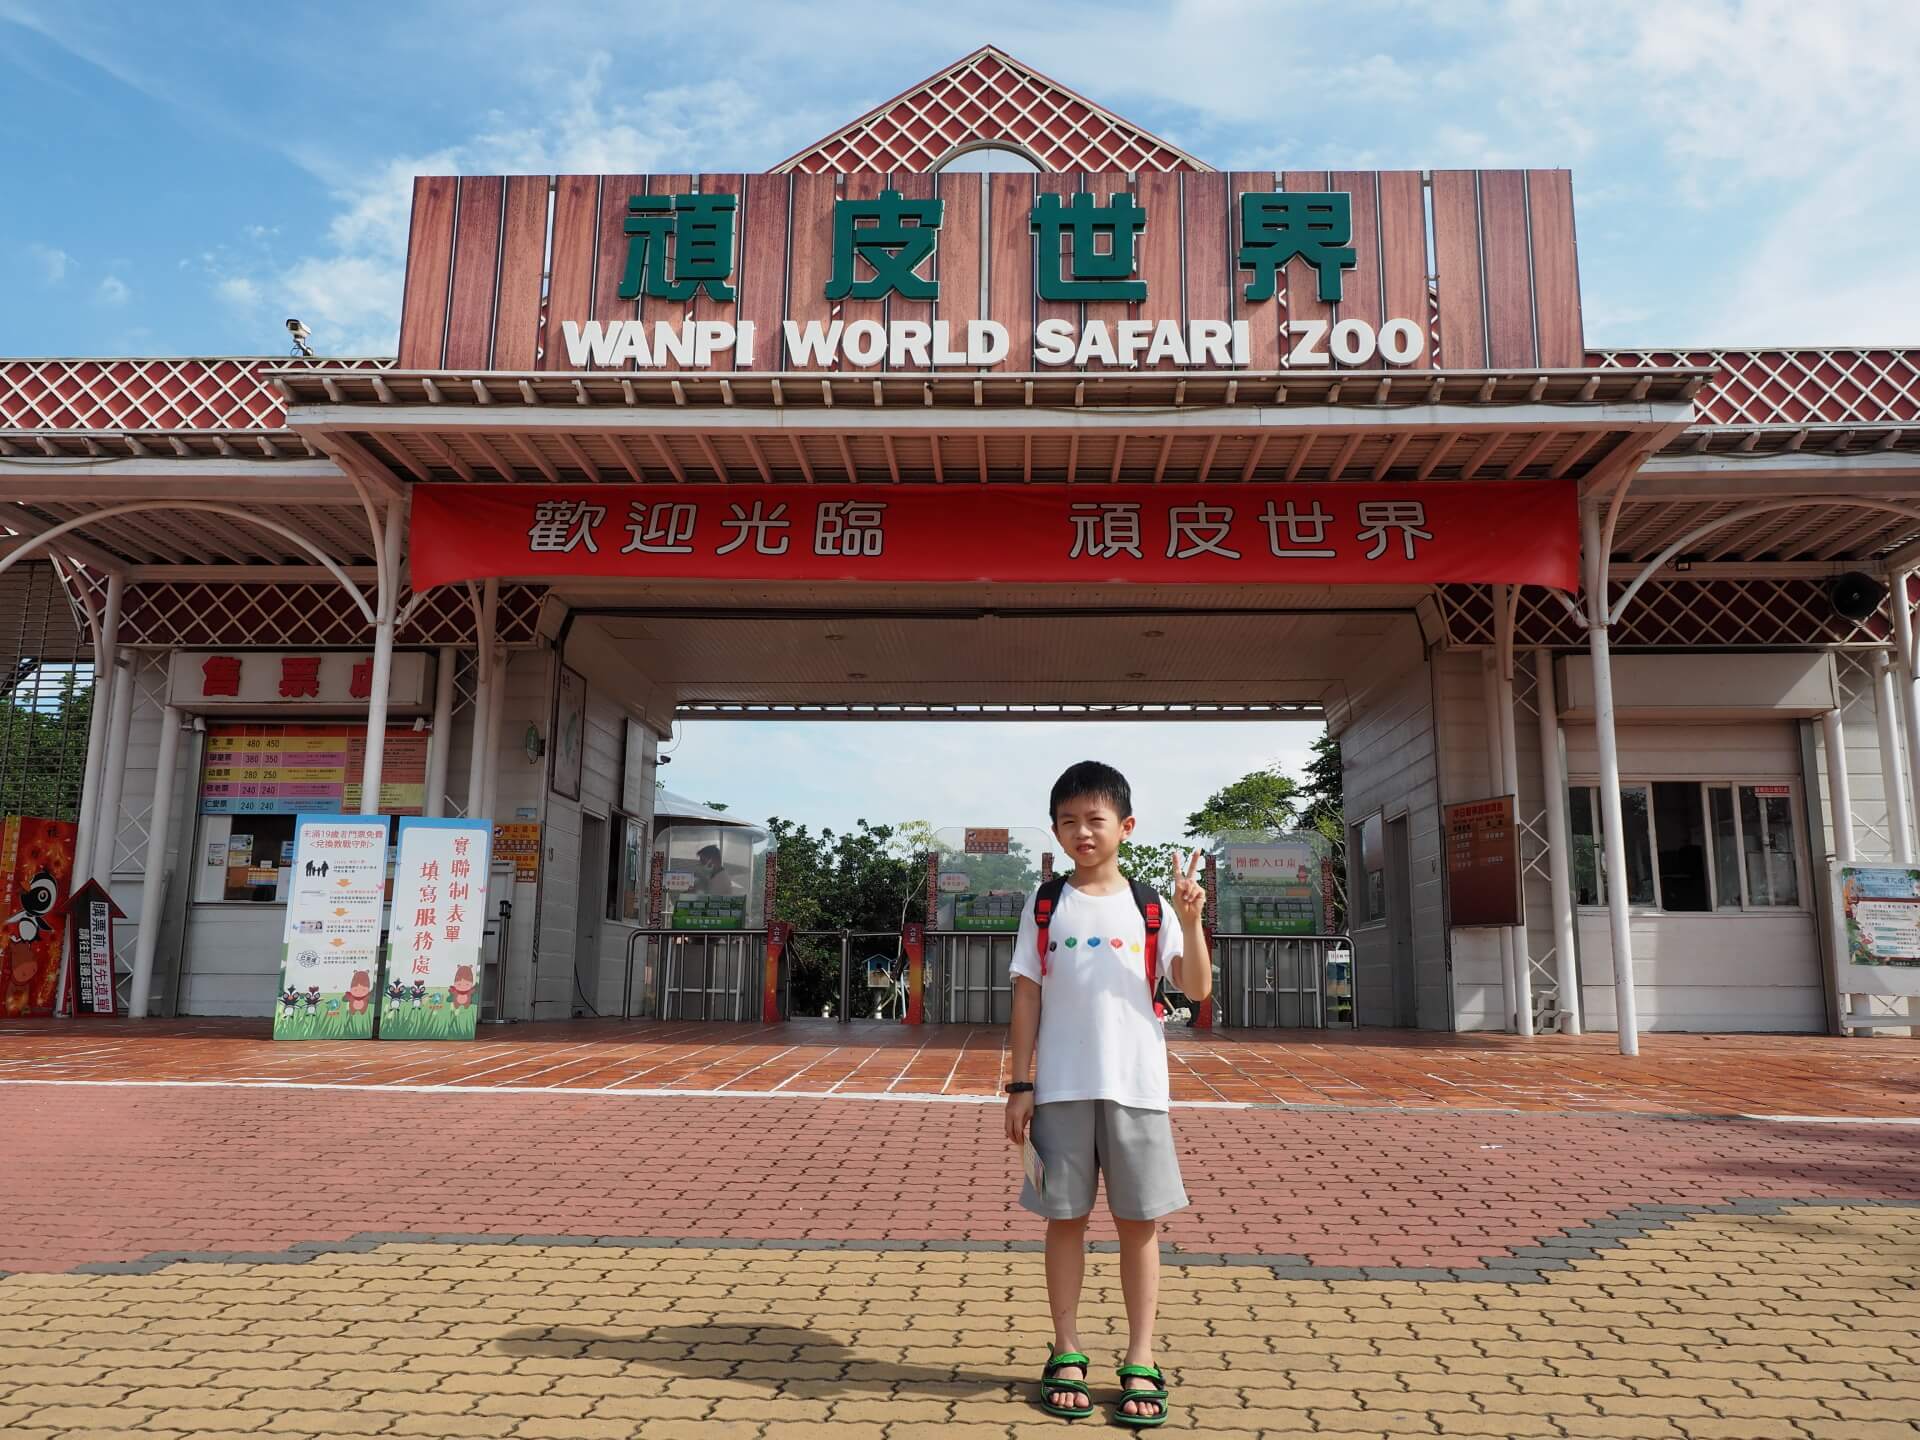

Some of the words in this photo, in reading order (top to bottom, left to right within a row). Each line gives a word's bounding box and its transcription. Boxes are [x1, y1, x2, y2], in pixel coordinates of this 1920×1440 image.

[619, 190, 1357, 303] 頑皮世界
[562, 320, 756, 367] WANPI
[783, 319, 1010, 367] WORLD
[1034, 319, 1250, 367] SAFARI
[1288, 319, 1424, 367] ZOO
[527, 500, 888, 557] 歡迎光臨
[1069, 500, 1433, 561] 頑皮世界
[241, 802, 254, 811] 240
[260, 802, 274, 811] 240
[411, 860, 440, 975] 填寫服務處
[443, 836, 471, 943] 實聯制表單
